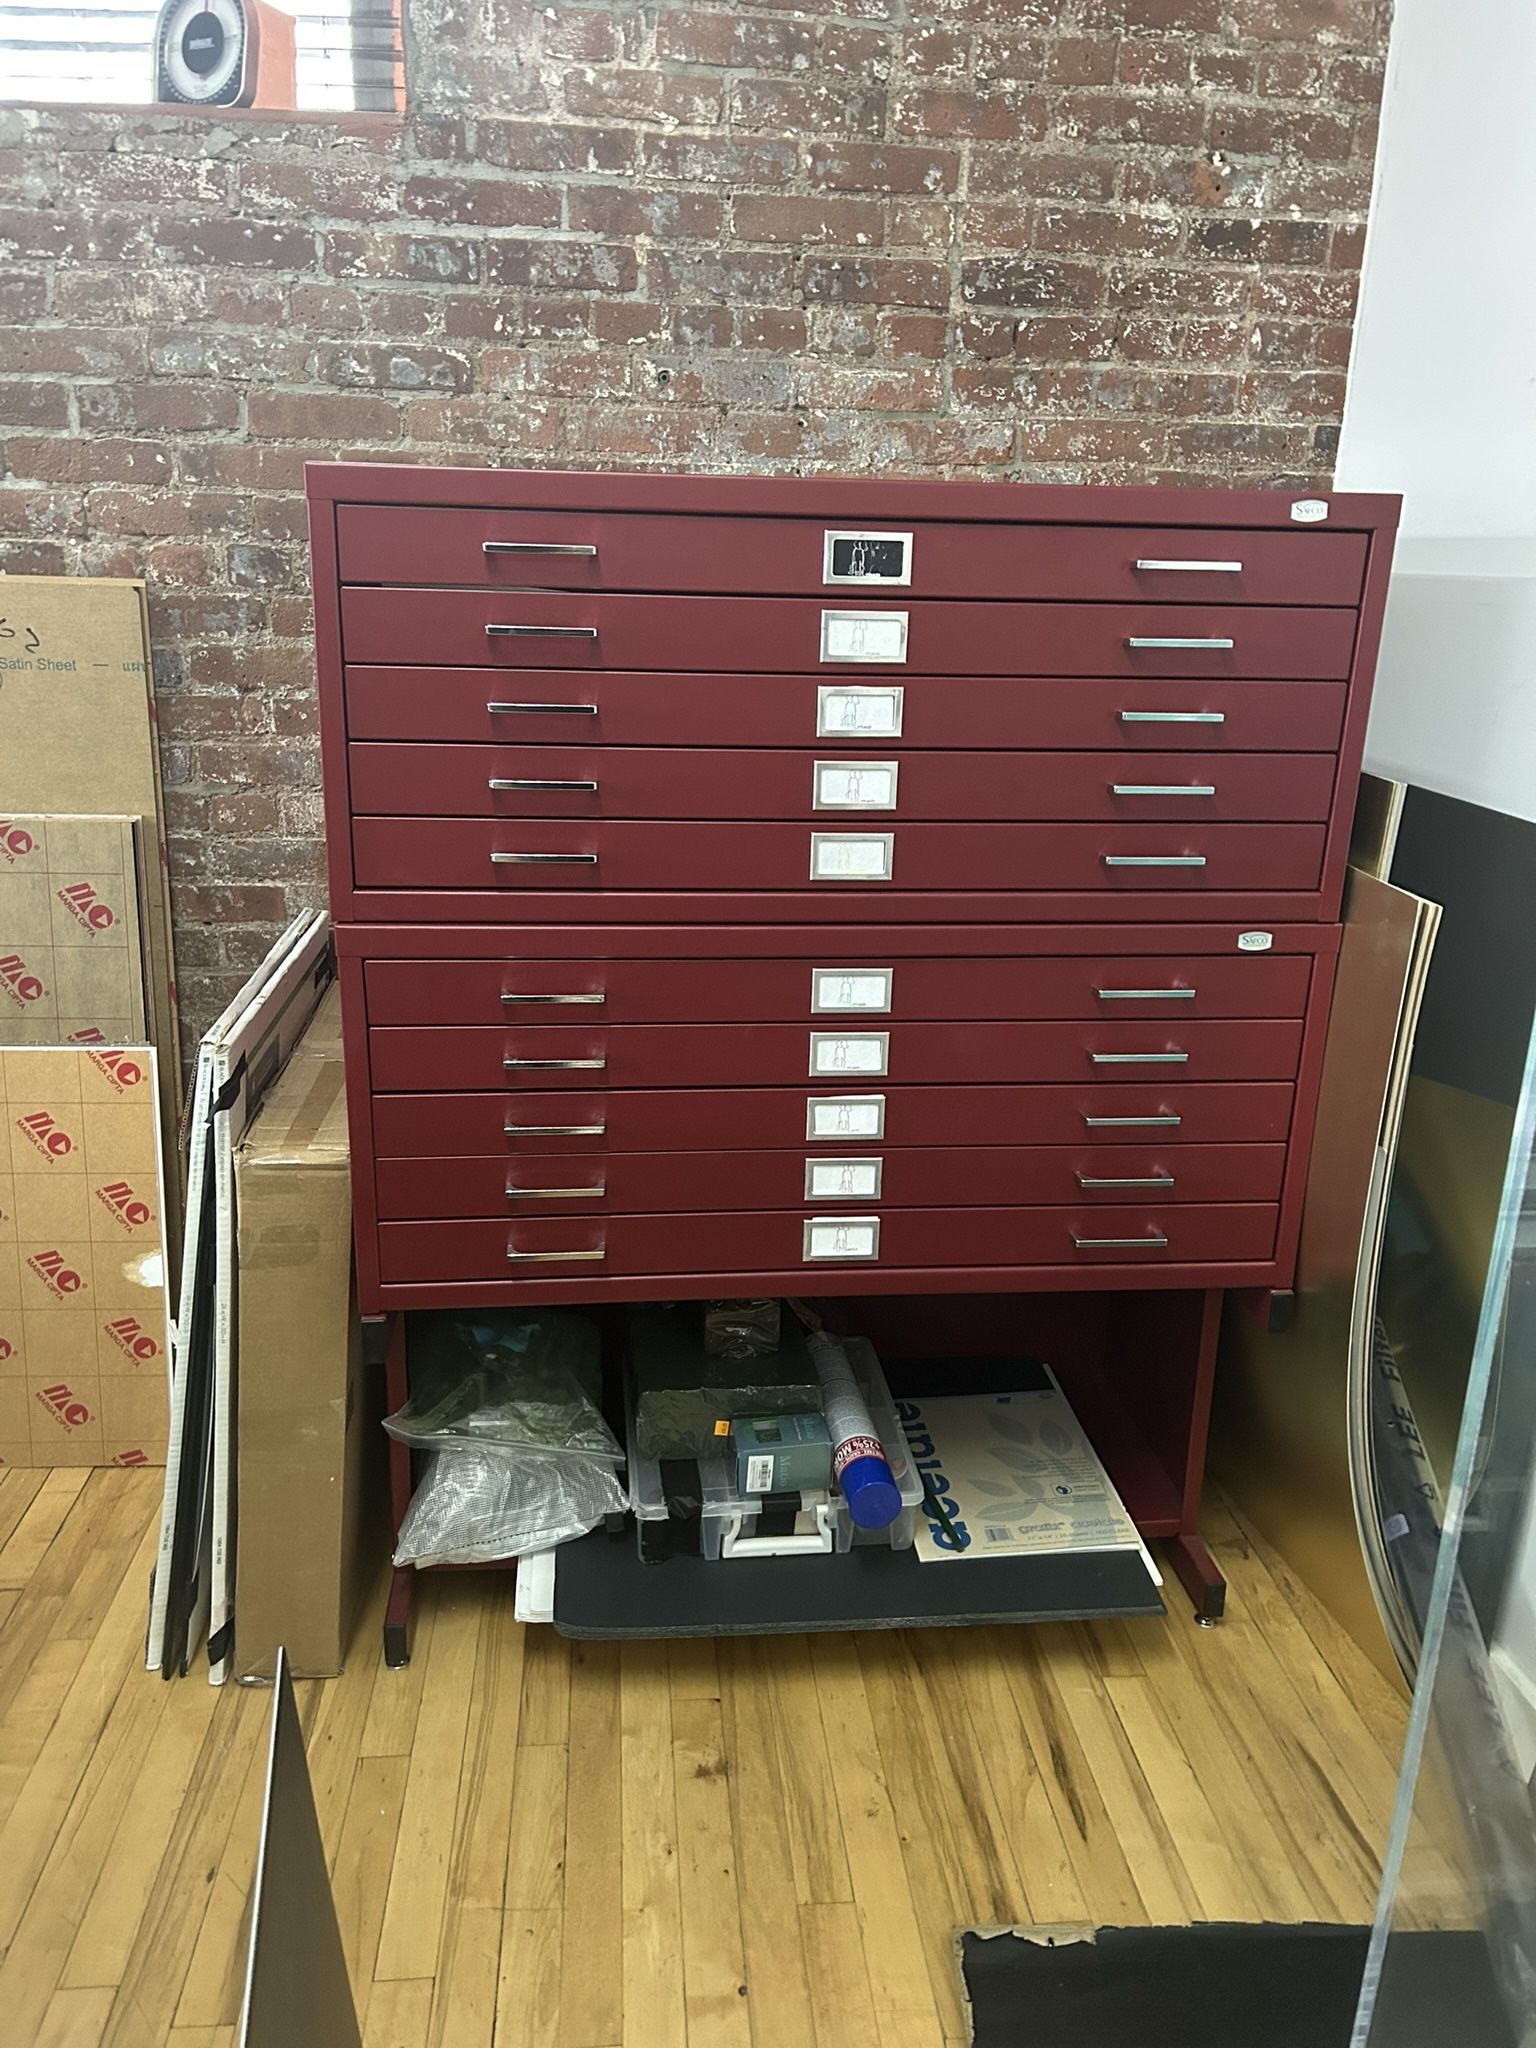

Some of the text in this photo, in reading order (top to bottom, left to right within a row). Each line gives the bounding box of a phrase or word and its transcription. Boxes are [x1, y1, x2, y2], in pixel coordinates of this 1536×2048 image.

[0, 656, 77, 671] Satin Sheet
[79, 917, 97, 939] CIPTA
[8, 988, 26, 1010] CIPTA
[106, 1074, 125, 1095] CIPTA
[15, 1119, 55, 1165] MARGA CIPTA
[95, 1189, 134, 1234] MARGA CIPTA
[26, 1257, 64, 1302] MARGA CIPTA
[103, 1324, 141, 1368] MARGA CIPTA
[34, 1391, 73, 1435] MARGA CIPTA
